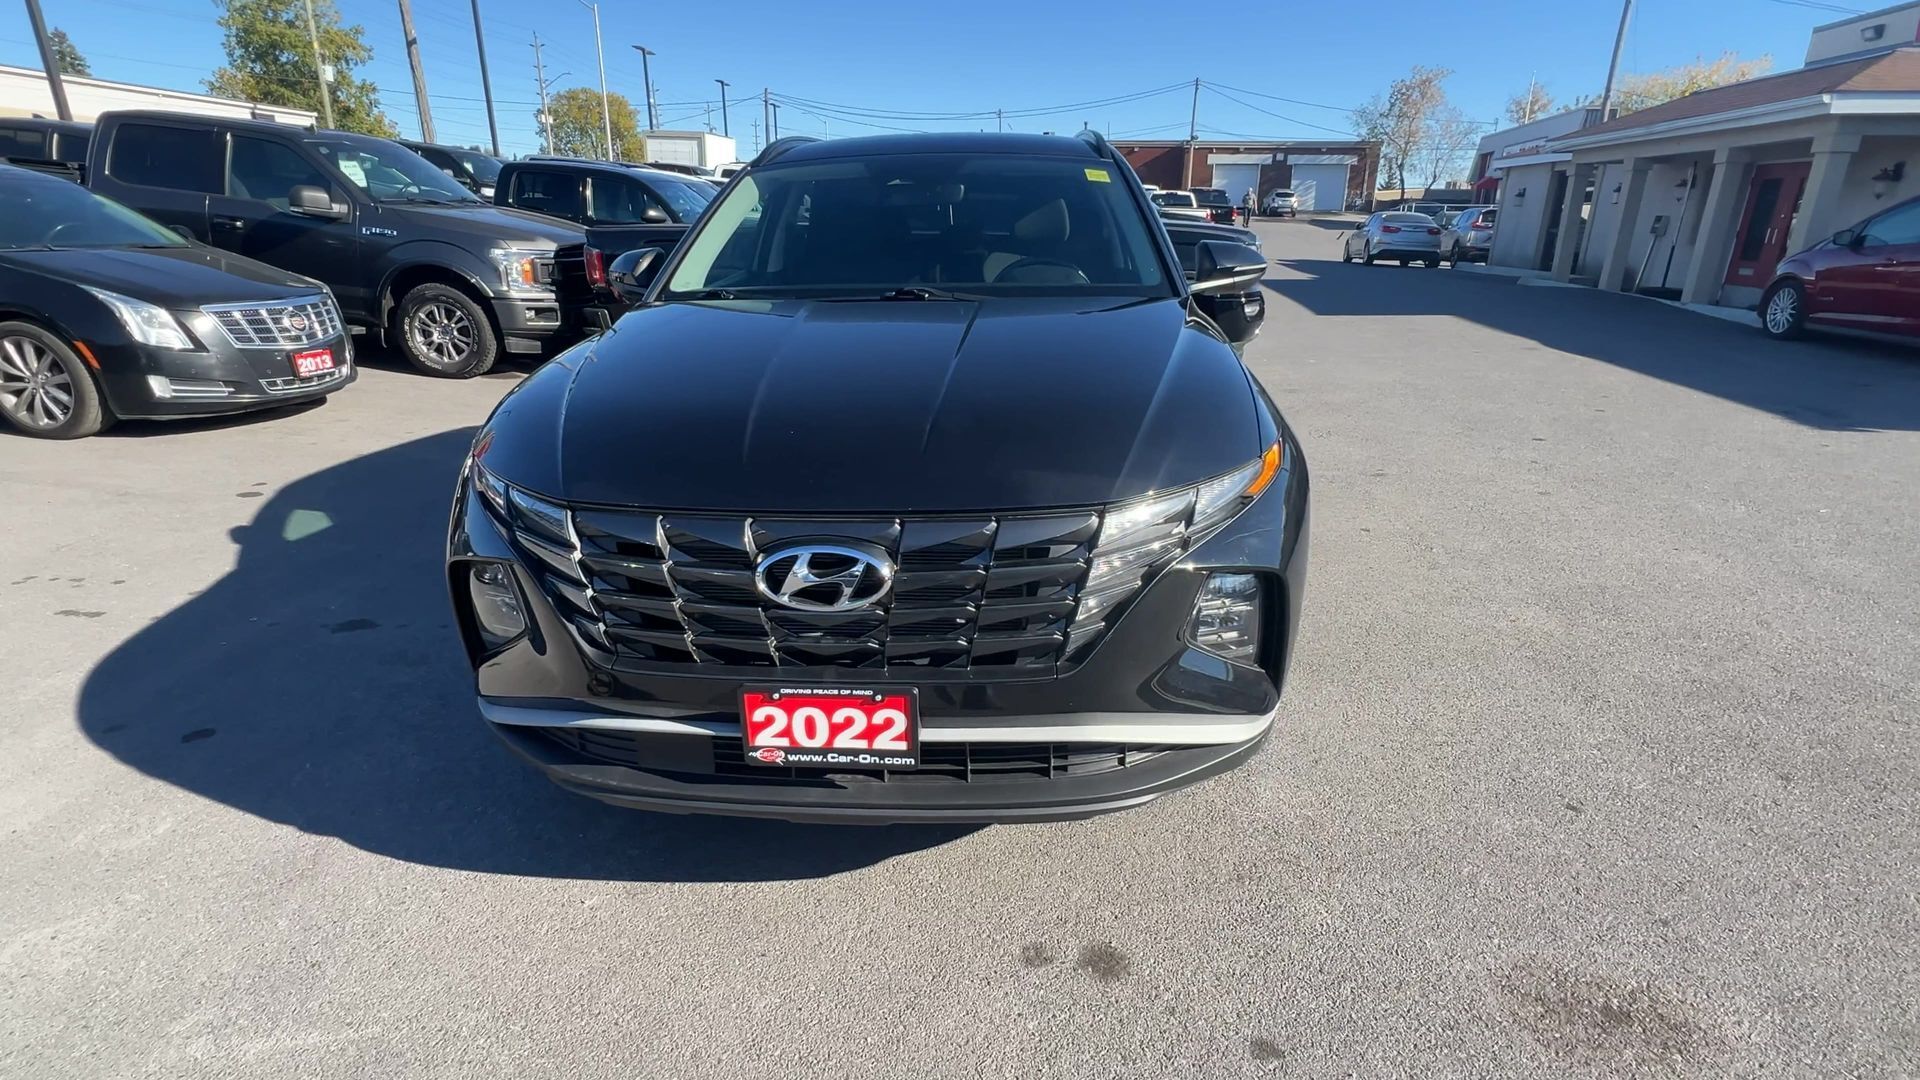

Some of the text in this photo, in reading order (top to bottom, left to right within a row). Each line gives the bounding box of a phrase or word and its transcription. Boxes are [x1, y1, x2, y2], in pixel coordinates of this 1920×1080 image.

[297, 354, 331, 373] 2013
[752, 706, 908, 750] 2022
[787, 753, 915, 765] www.Car-On.com
